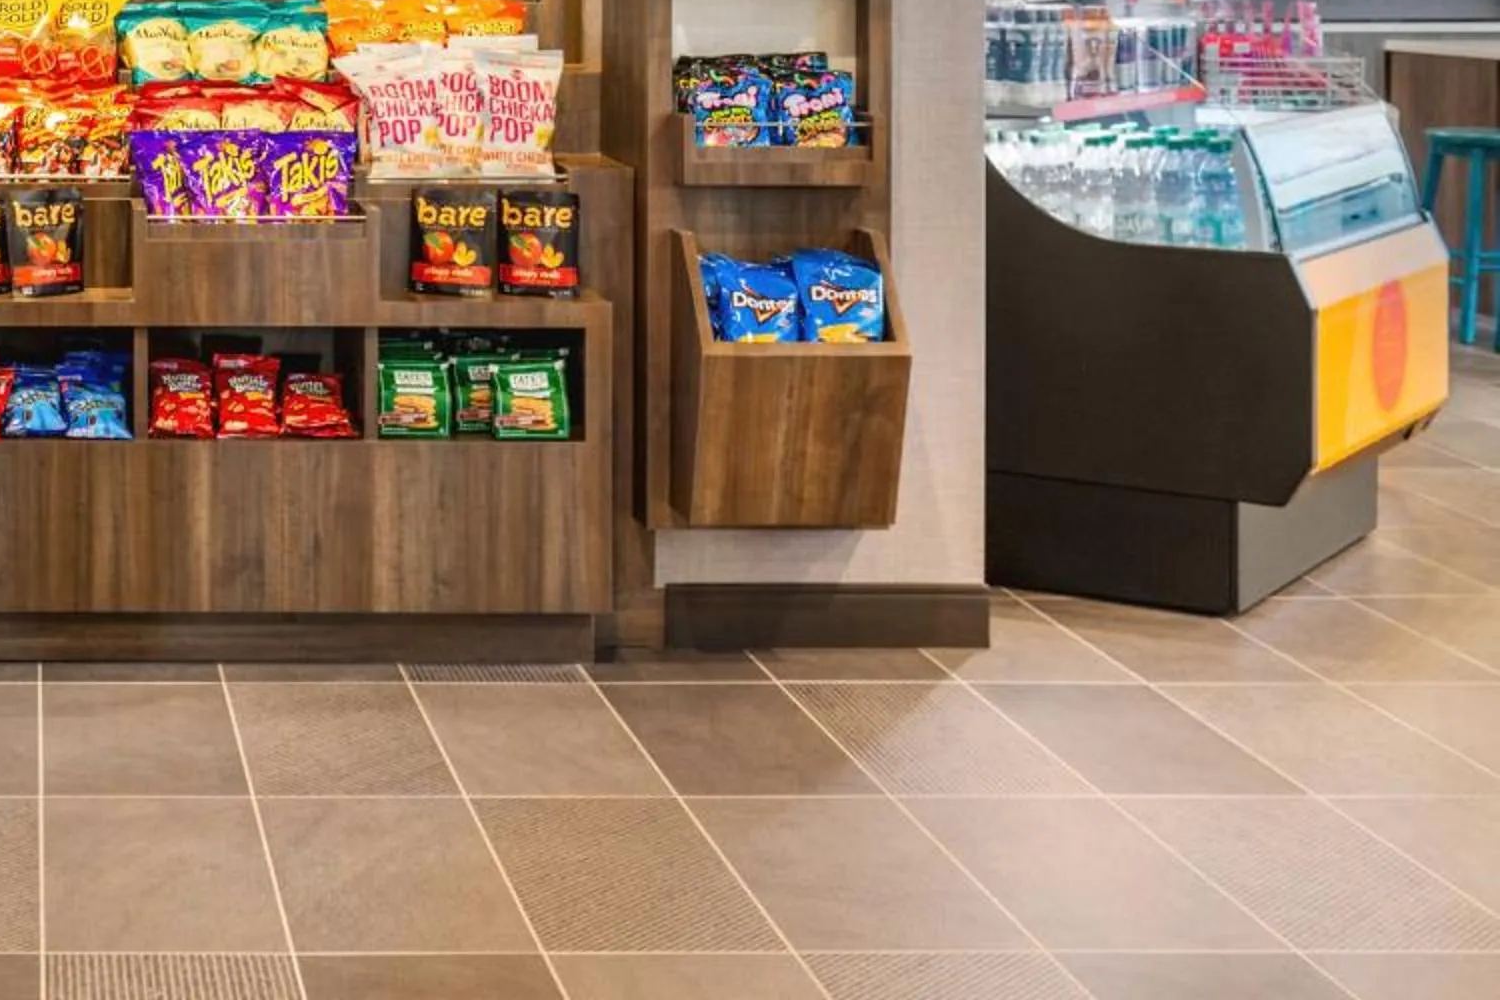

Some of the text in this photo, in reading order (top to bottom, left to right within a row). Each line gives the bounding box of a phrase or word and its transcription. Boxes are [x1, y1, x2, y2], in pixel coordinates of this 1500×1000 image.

[0, 0, 43, 13] ROLD
[377, 119, 422, 147] POP
[489, 116, 535, 143] POP
[193, 149, 254, 206] Takis
[274, 149, 339, 203] Takis
[12, 200, 76, 228] bare
[417, 197, 488, 227] bare
[501, 198, 573, 229] bare
[810, 285, 878, 303] Doritos
